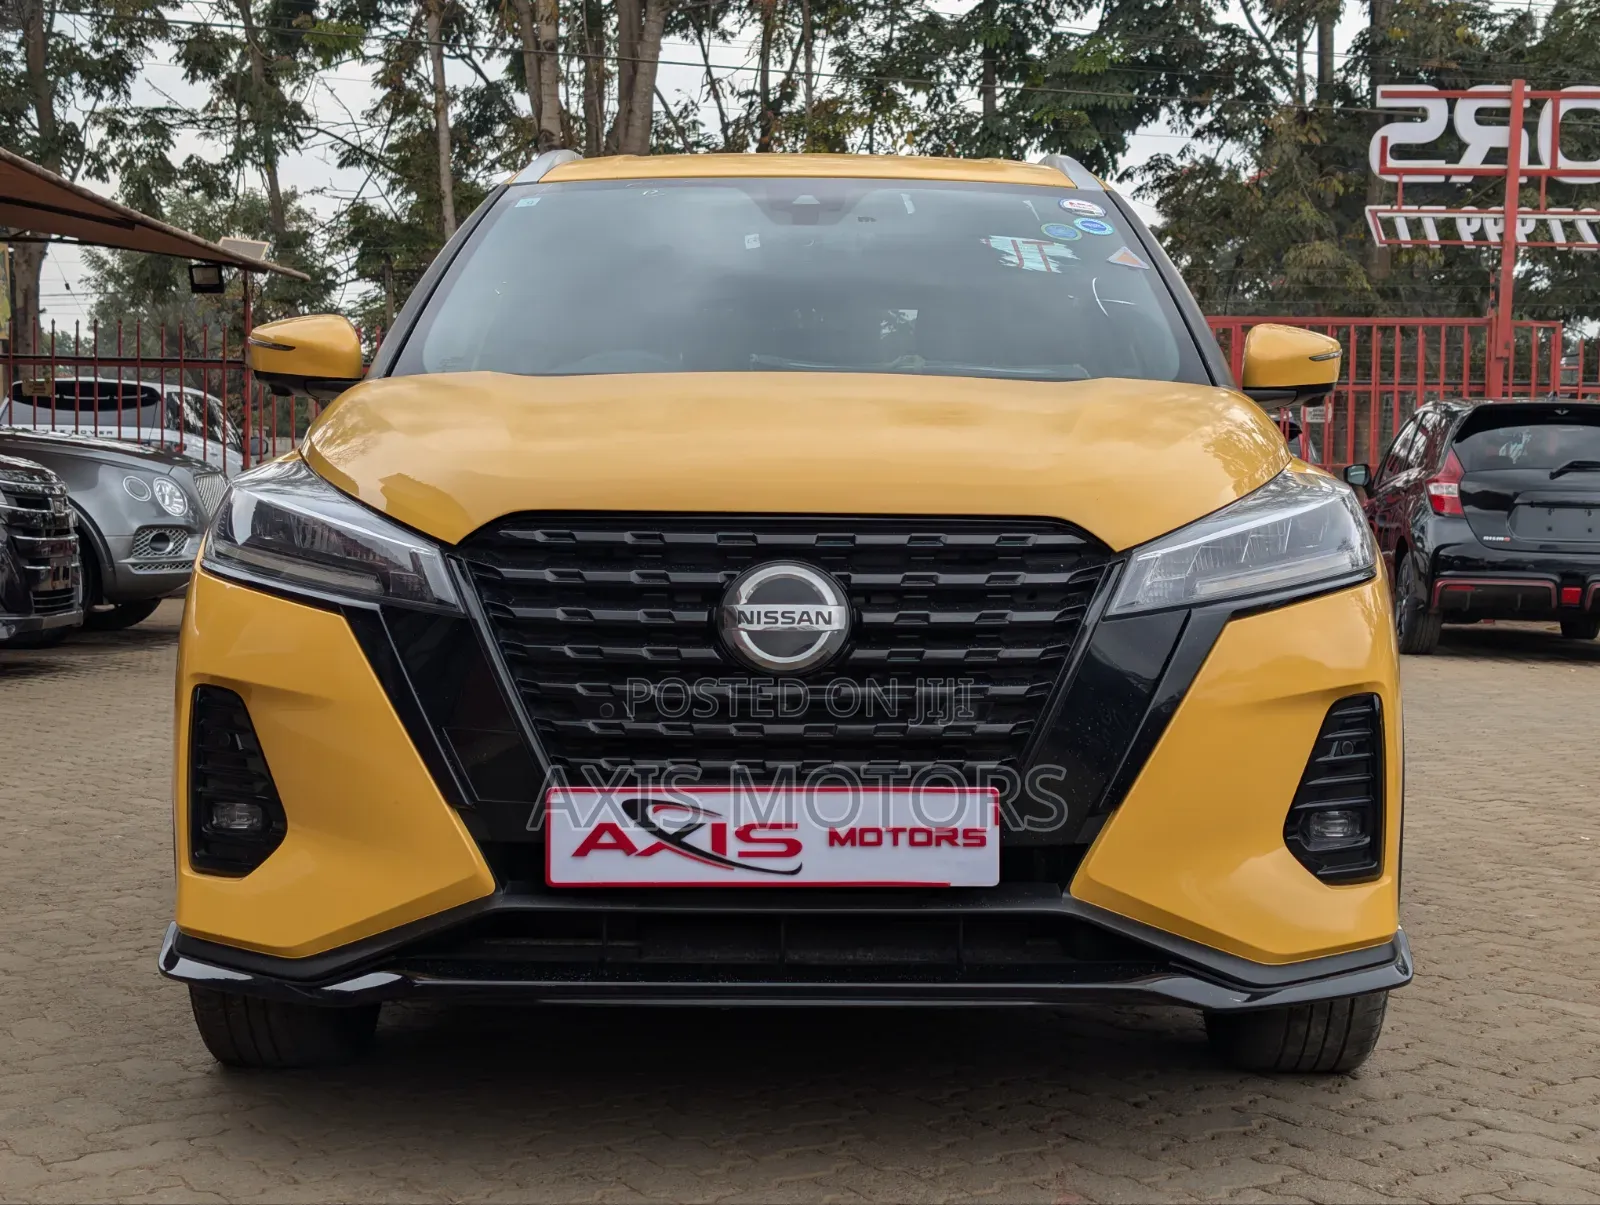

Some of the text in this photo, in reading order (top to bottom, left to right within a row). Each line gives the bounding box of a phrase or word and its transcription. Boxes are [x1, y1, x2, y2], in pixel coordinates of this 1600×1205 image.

[737, 610, 832, 625] NISSAN
[571, 799, 988, 875] AXIS MOTORS
